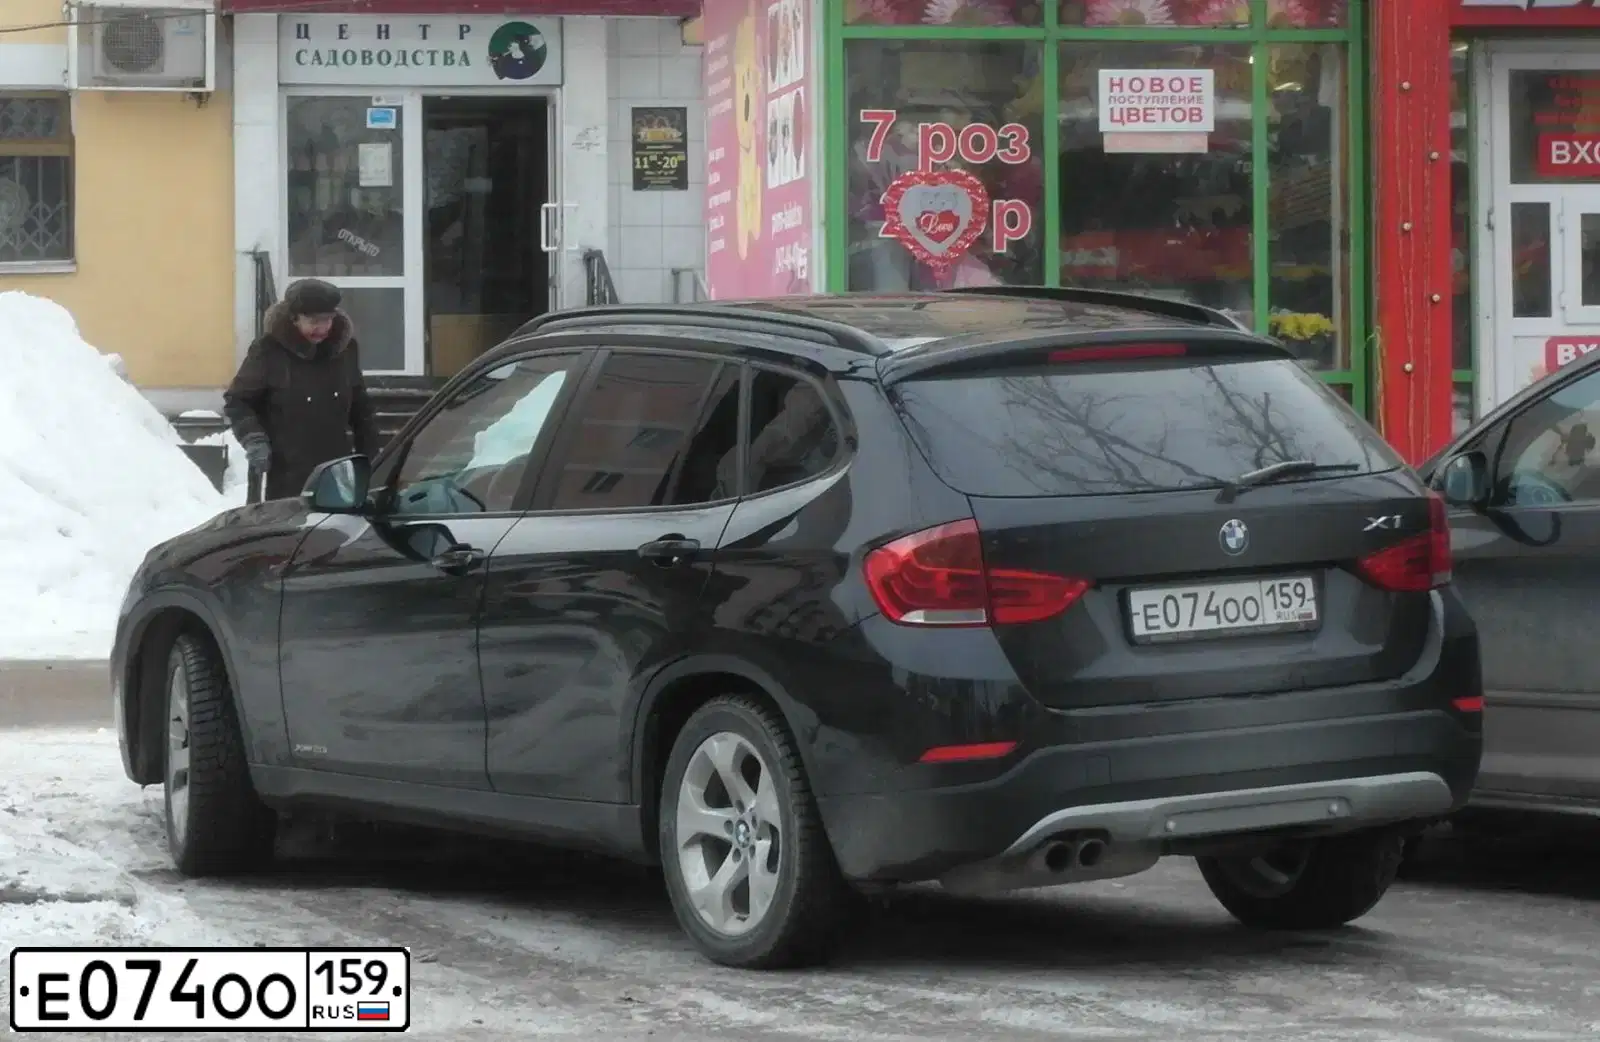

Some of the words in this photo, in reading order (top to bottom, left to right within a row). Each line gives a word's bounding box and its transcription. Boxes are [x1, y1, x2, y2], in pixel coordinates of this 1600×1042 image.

[295, 23, 472, 43] ЦЕНТР
[295, 49, 472, 67] САДОВОДСТВА
[1108, 76, 1204, 94] НОВОЕ
[1107, 95, 1205, 105] ПОСТУПЛЕНИЕ
[1108, 106, 1204, 126] ЦВЕТОВ
[859, 109, 897, 162] 7
[918, 122, 1031, 173] роз
[992, 198, 1032, 253] р
[337, 228, 381, 257] ОТКРЫТО
[1363, 514, 1403, 532] X1
[1265, 581, 1307, 611] 159
[1276, 609, 1297, 621] RUS
